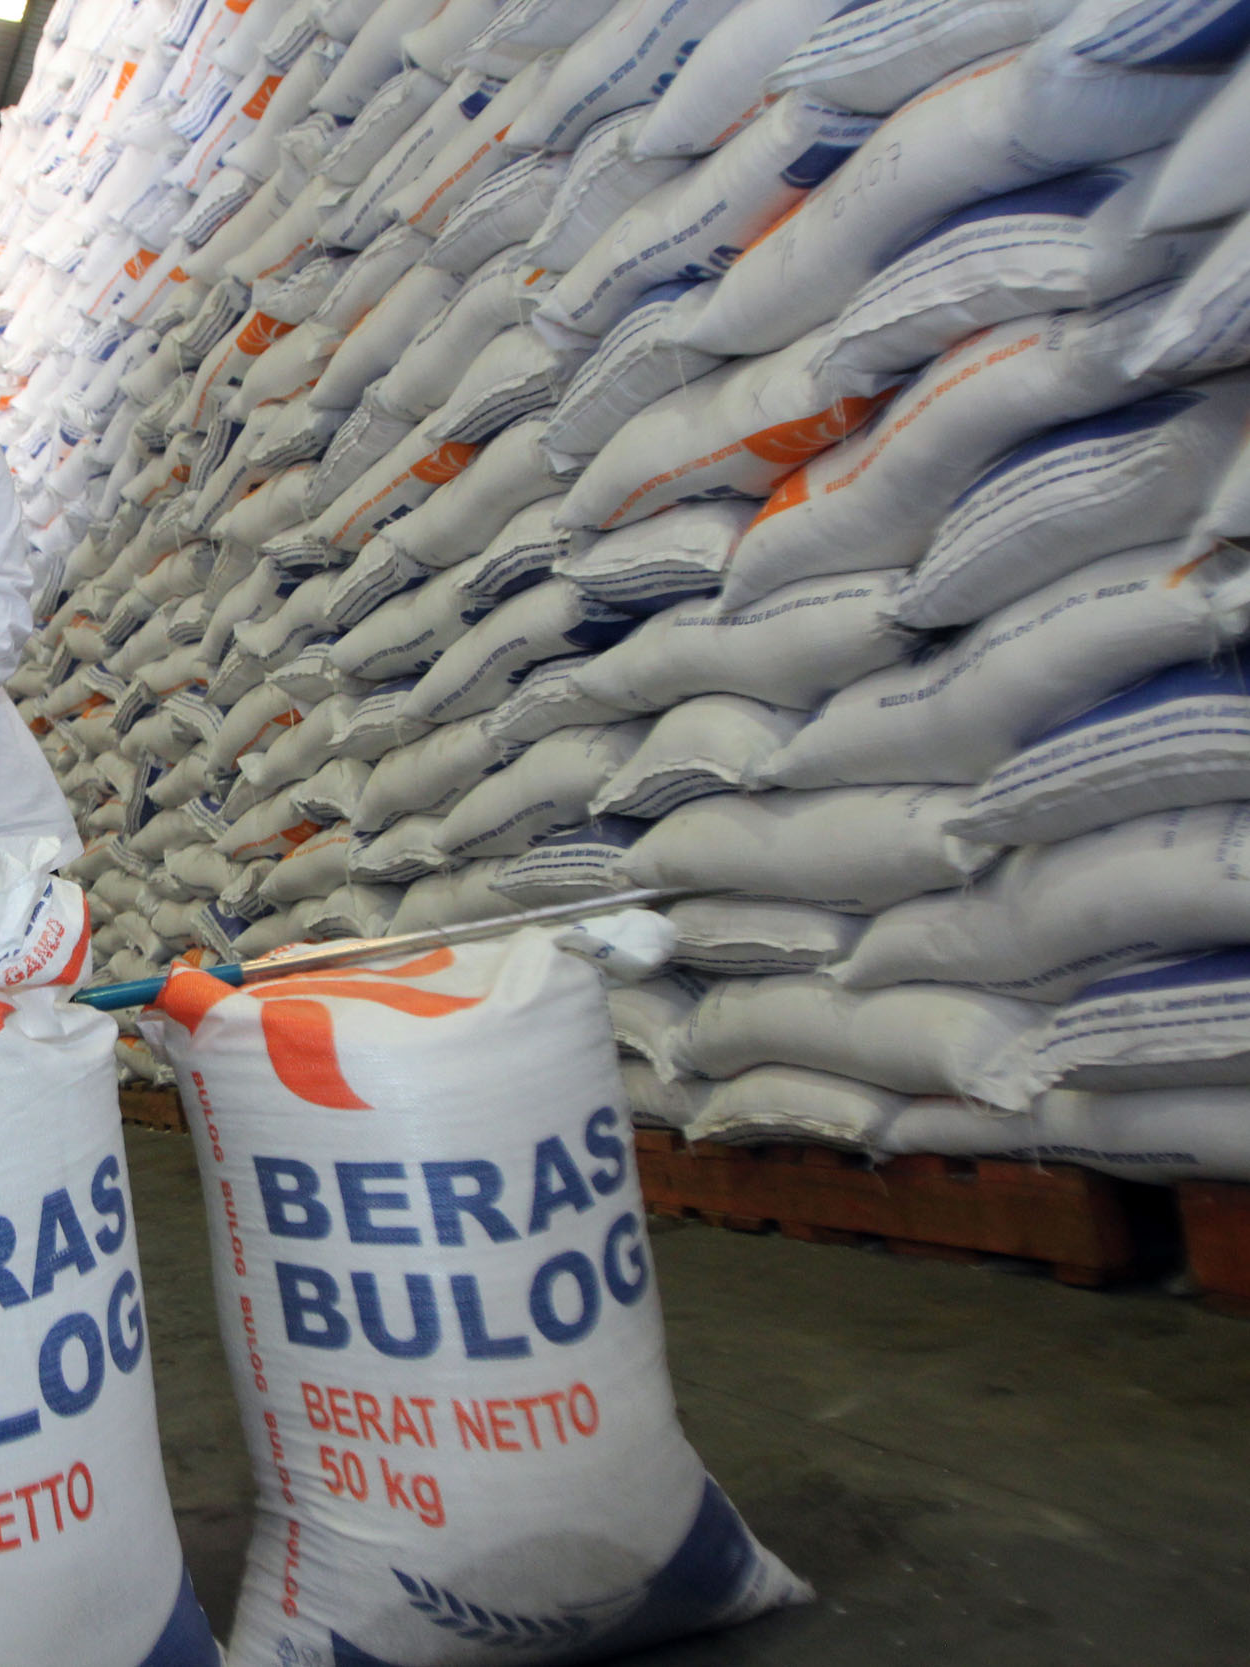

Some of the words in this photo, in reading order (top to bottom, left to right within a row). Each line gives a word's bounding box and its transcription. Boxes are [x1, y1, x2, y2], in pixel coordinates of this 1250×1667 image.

[253, 1106, 627, 1247] BERAS
[190, 1070, 224, 1163] BULOG
[220, 1178, 246, 1278] BULOG
[240, 1295, 268, 1394] BULOG
[263, 1410, 296, 1506] BULOG
[274, 1212, 649, 1361] BULOG
[300, 1381, 437, 1450] BERAT
[452, 1382, 600, 1452] NETTO
[318, 1445, 369, 1501] 50
[379, 1456, 446, 1529] kg
